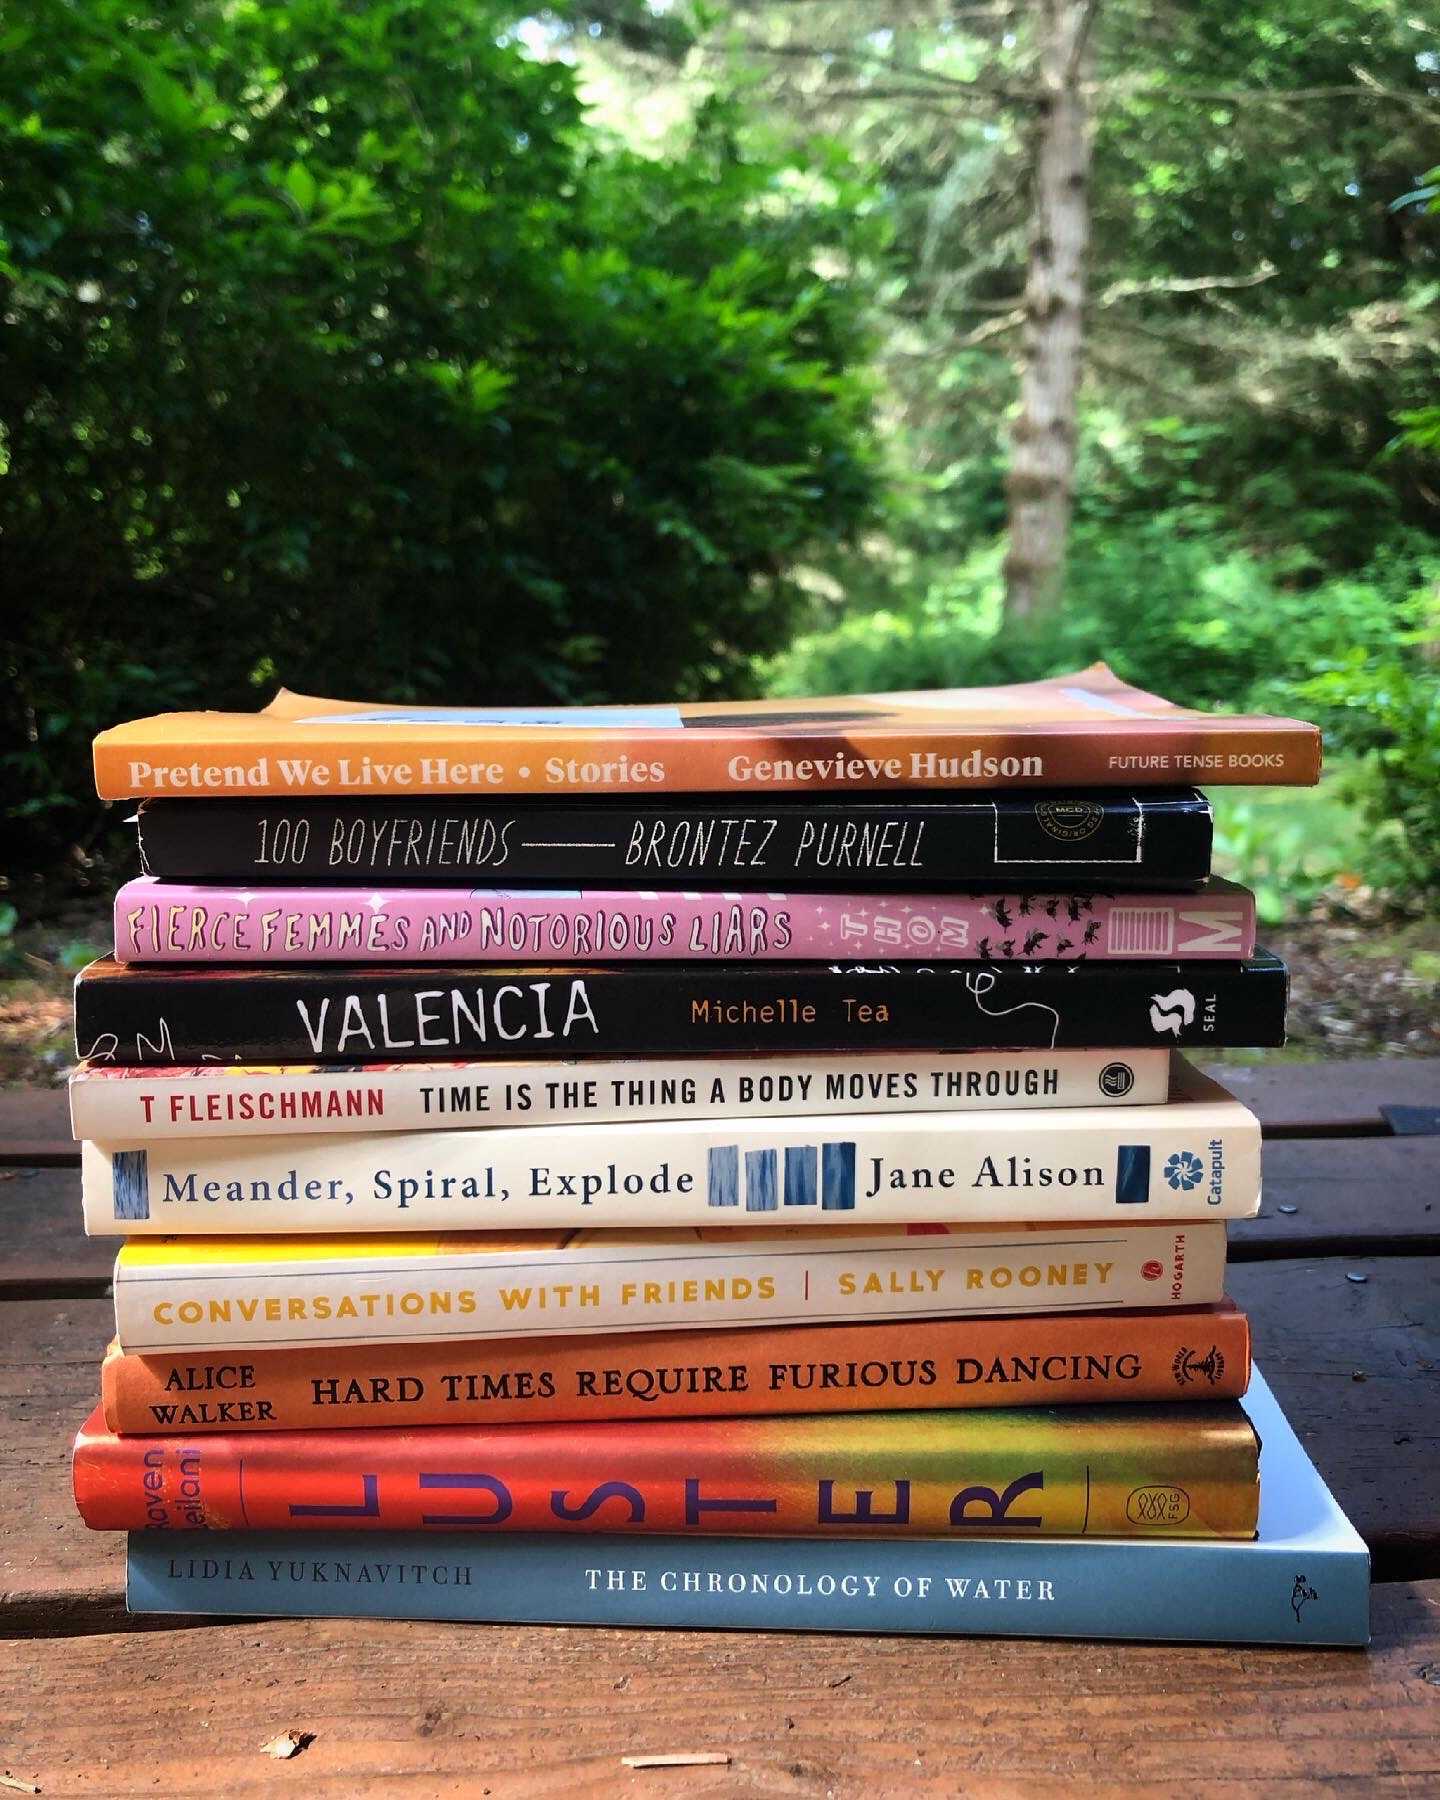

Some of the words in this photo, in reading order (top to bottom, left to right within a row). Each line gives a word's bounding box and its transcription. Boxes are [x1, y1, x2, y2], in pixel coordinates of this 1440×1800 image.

[128, 758, 270, 789] Pretend
[277, 759, 330, 787] We
[338, 756, 413, 786] Live
[421, 758, 504, 785] Here
[545, 755, 665, 785] Stories
[727, 752, 902, 783] Genevieve
[909, 750, 1044, 780] Hudson
[1109, 755, 1169, 769] FUTURE
[1174, 755, 1223, 769] TENSE
[1228, 754, 1284, 768] BOOKS
[255, 819, 311, 866] 100
[329, 818, 516, 867] BOYFRIENDS
[625, 819, 779, 868] BRONTEZ
[795, 821, 926, 868] PURNELL
[126, 906, 253, 955] FIERCE
[261, 909, 410, 954] FEMMES
[419, 909, 473, 952] AND
[480, 907, 675, 953] NOTORIOUS
[689, 904, 792, 956] LIARS
[296, 979, 600, 1055] VALENCIA
[691, 997, 817, 1025] Michelle
[843, 998, 889, 1025] Tea
[1203, 993, 1218, 1033] SEAL
[140, 1096, 154, 1123] T
[170, 1089, 385, 1122] FLEISCHMANN
[420, 1081, 490, 1115] TIME
[505, 1083, 532, 1112] IS
[546, 1082, 598, 1110] THE
[612, 1078, 697, 1108] THING
[709, 1074, 726, 1104] A
[738, 1073, 811, 1102] BODY
[825, 1071, 918, 1100] MOVES
[930, 1068, 1060, 1098] THROUGH
[162, 1168, 354, 1205] Meander,
[373, 1166, 511, 1208] Spiral,
[529, 1163, 695, 1208] Explode
[866, 1154, 955, 1198] Jane
[971, 1153, 1106, 1190] Alison
[1207, 1138, 1225, 1206] Catapult
[838, 1268, 946, 1297] SALLY
[966, 1261, 1116, 1290] ROONEY
[1171, 1234, 1186, 1301] HOGARTH
[153, 1289, 477, 1326] CONVERSATIONS
[500, 1284, 601, 1312] WITH
[621, 1275, 776, 1308] FRIENDS
[164, 1365, 256, 1393] ALICE
[311, 1375, 425, 1406] HARD
[440, 1371, 557, 1402] TIMES
[576, 1363, 749, 1405] REQUIRE
[768, 1358, 937, 1391] FURIOUS
[956, 1353, 1143, 1386] DANCING
[150, 1399, 278, 1425] WALKER
[288, 1471, 1044, 1528] LUSTER
[1167, 1492, 1181, 1520] FSG
[167, 1559, 255, 1582] LIDIA
[269, 1561, 474, 1587] YUKNAVITCH
[585, 1568, 647, 1592] THE
[660, 1571, 882, 1599] CHRONOLOGY
[893, 1576, 932, 1599] OF
[944, 1578, 1056, 1602] WATER
